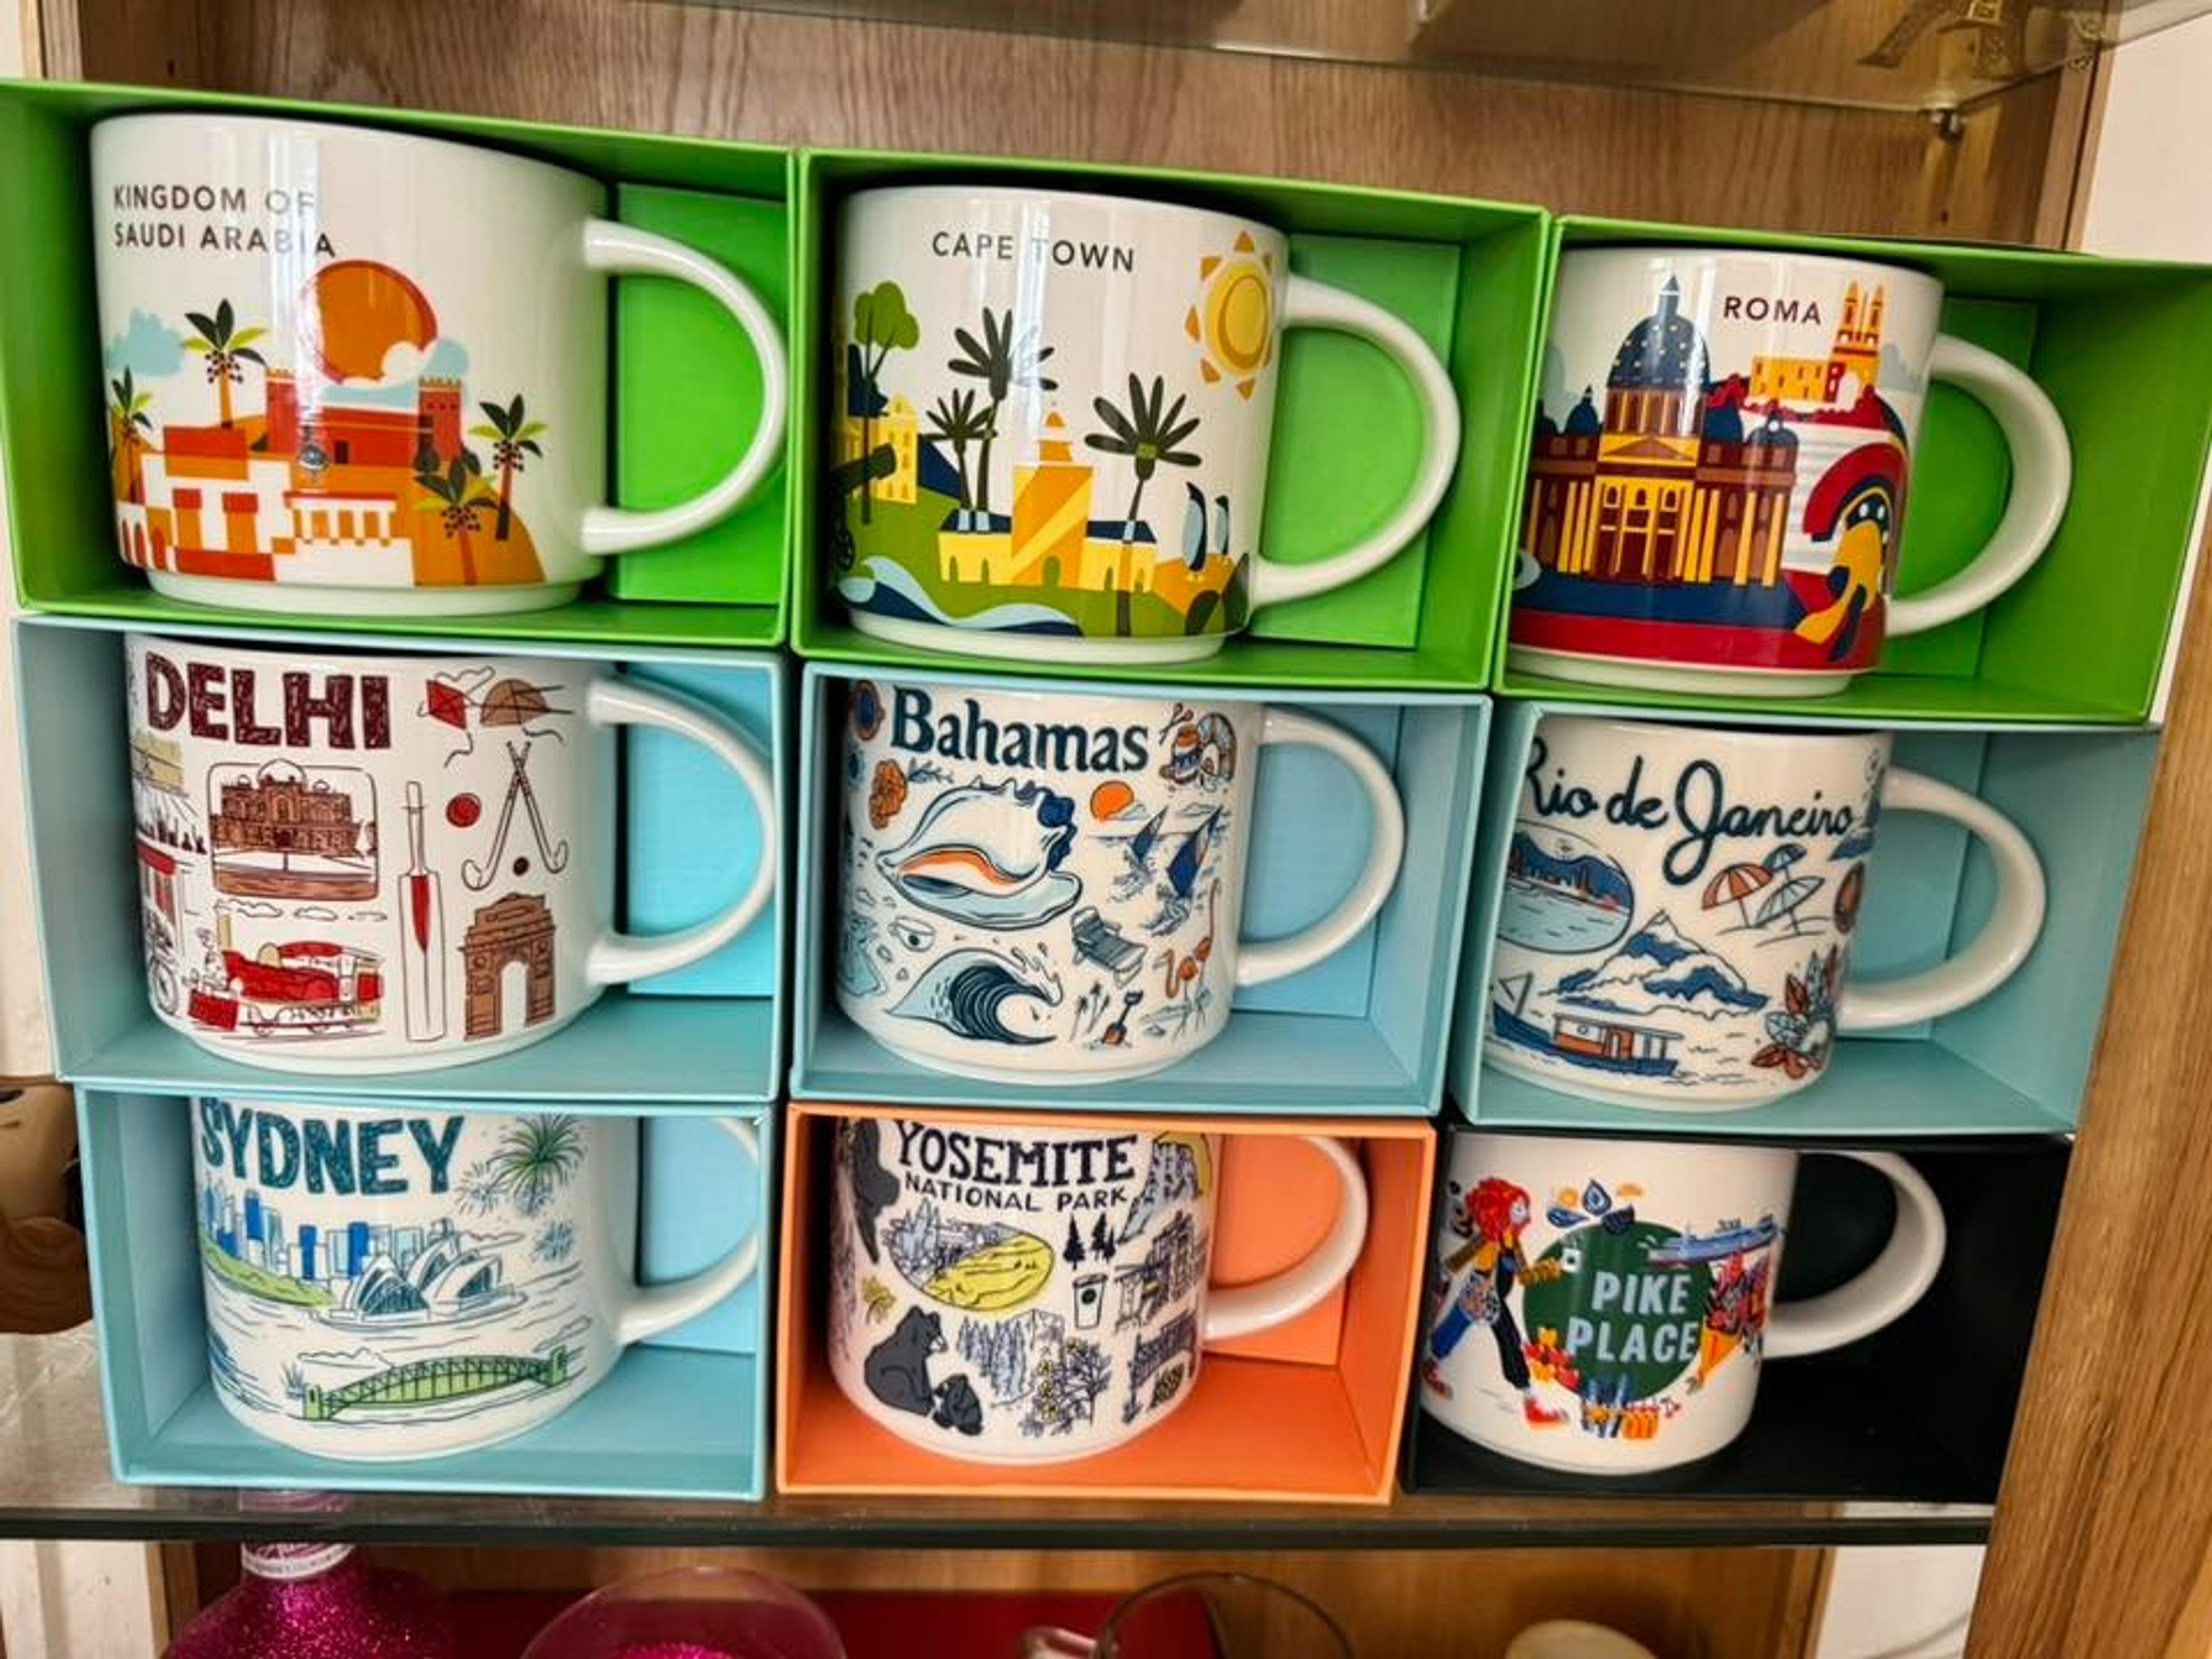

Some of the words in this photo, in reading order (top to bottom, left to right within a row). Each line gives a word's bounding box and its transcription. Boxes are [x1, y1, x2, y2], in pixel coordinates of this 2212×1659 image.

[113, 184, 247, 213] KINGDOM
[264, 189, 315, 217] OF
[115, 222, 185, 248] SAUDI
[199, 225, 335, 257] ARABIA
[932, 231, 1014, 260] CAPE
[1031, 237, 1134, 273] TOWN
[1724, 296, 1822, 325] ROMA
[145, 651, 391, 749] DELHI
[890, 685, 1149, 772] Bahamas
[1526, 737, 1597, 816] Rio
[1605, 755, 1668, 828] de
[1662, 759, 1854, 885] Janeiro
[200, 1096, 464, 1195] SYDNEY
[895, 1119, 1138, 1187] YOSEMITE
[905, 1172, 1041, 1212] NATIONAL
[1057, 1187, 1127, 1212] PARK
[1591, 1271, 1692, 1314] PIKE
[1565, 1316, 1699, 1363] PLACE
